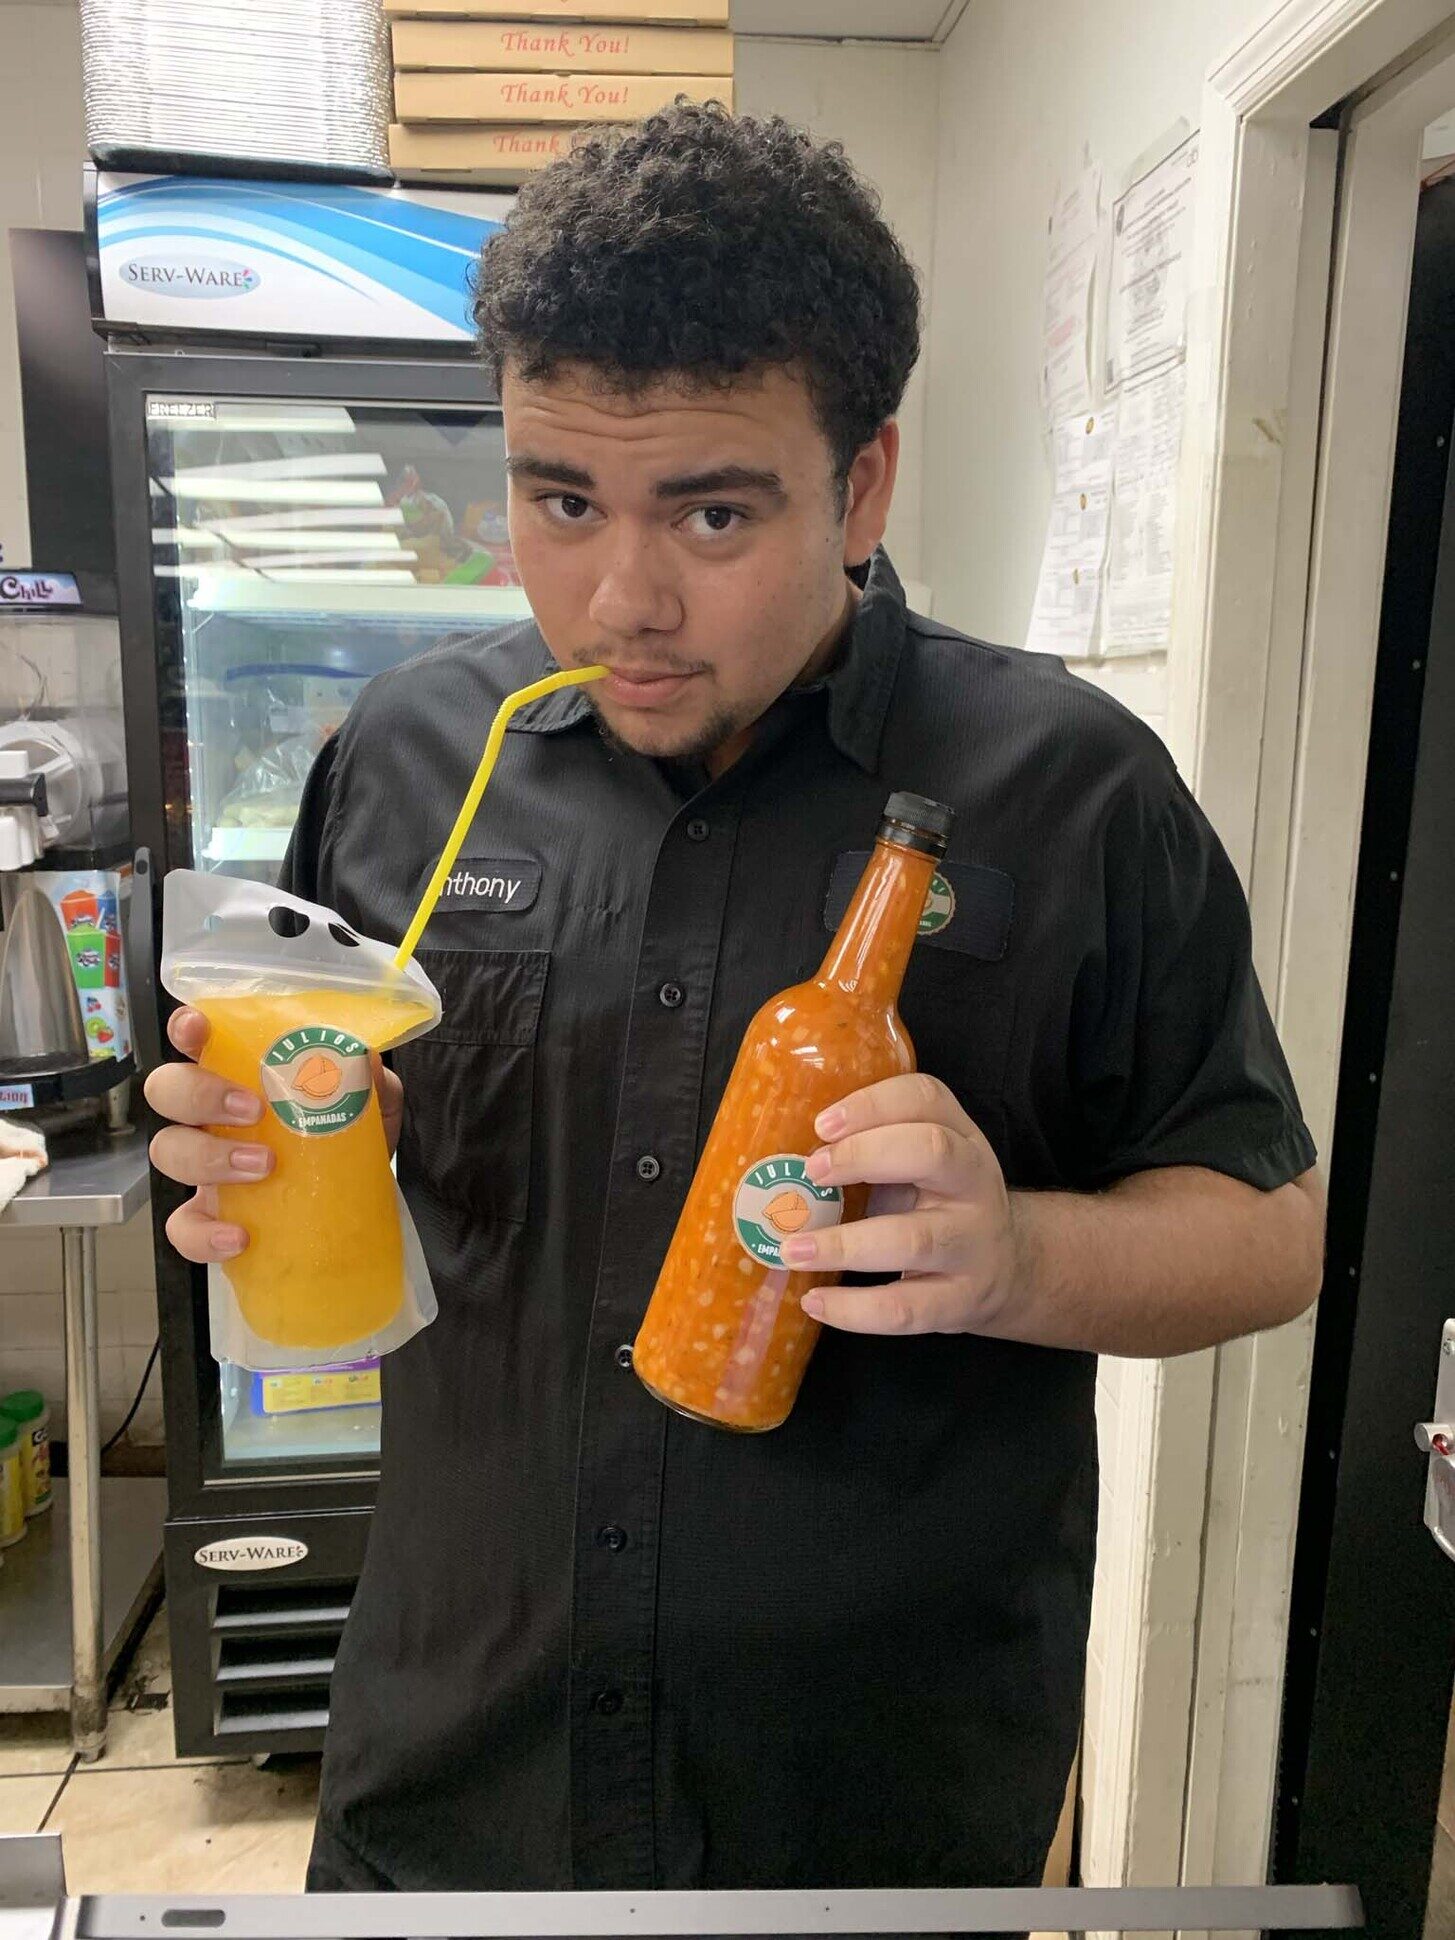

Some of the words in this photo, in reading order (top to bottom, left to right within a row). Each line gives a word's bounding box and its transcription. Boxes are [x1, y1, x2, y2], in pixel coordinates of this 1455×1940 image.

[501, 31, 575, 57] Thank
[579, 32, 630, 54] You!
[501, 83, 574, 109] Thank
[578, 83, 629, 105] You!
[128, 263, 243, 287] SERV-WARE
[440, 871, 521, 904] nthony
[272, 1030, 359, 1062] JULIOS
[298, 1112, 347, 1128] EMPANADAS
[755, 1162, 833, 1197] JULIS
[199, 1546, 297, 1564] SERV-WARE
